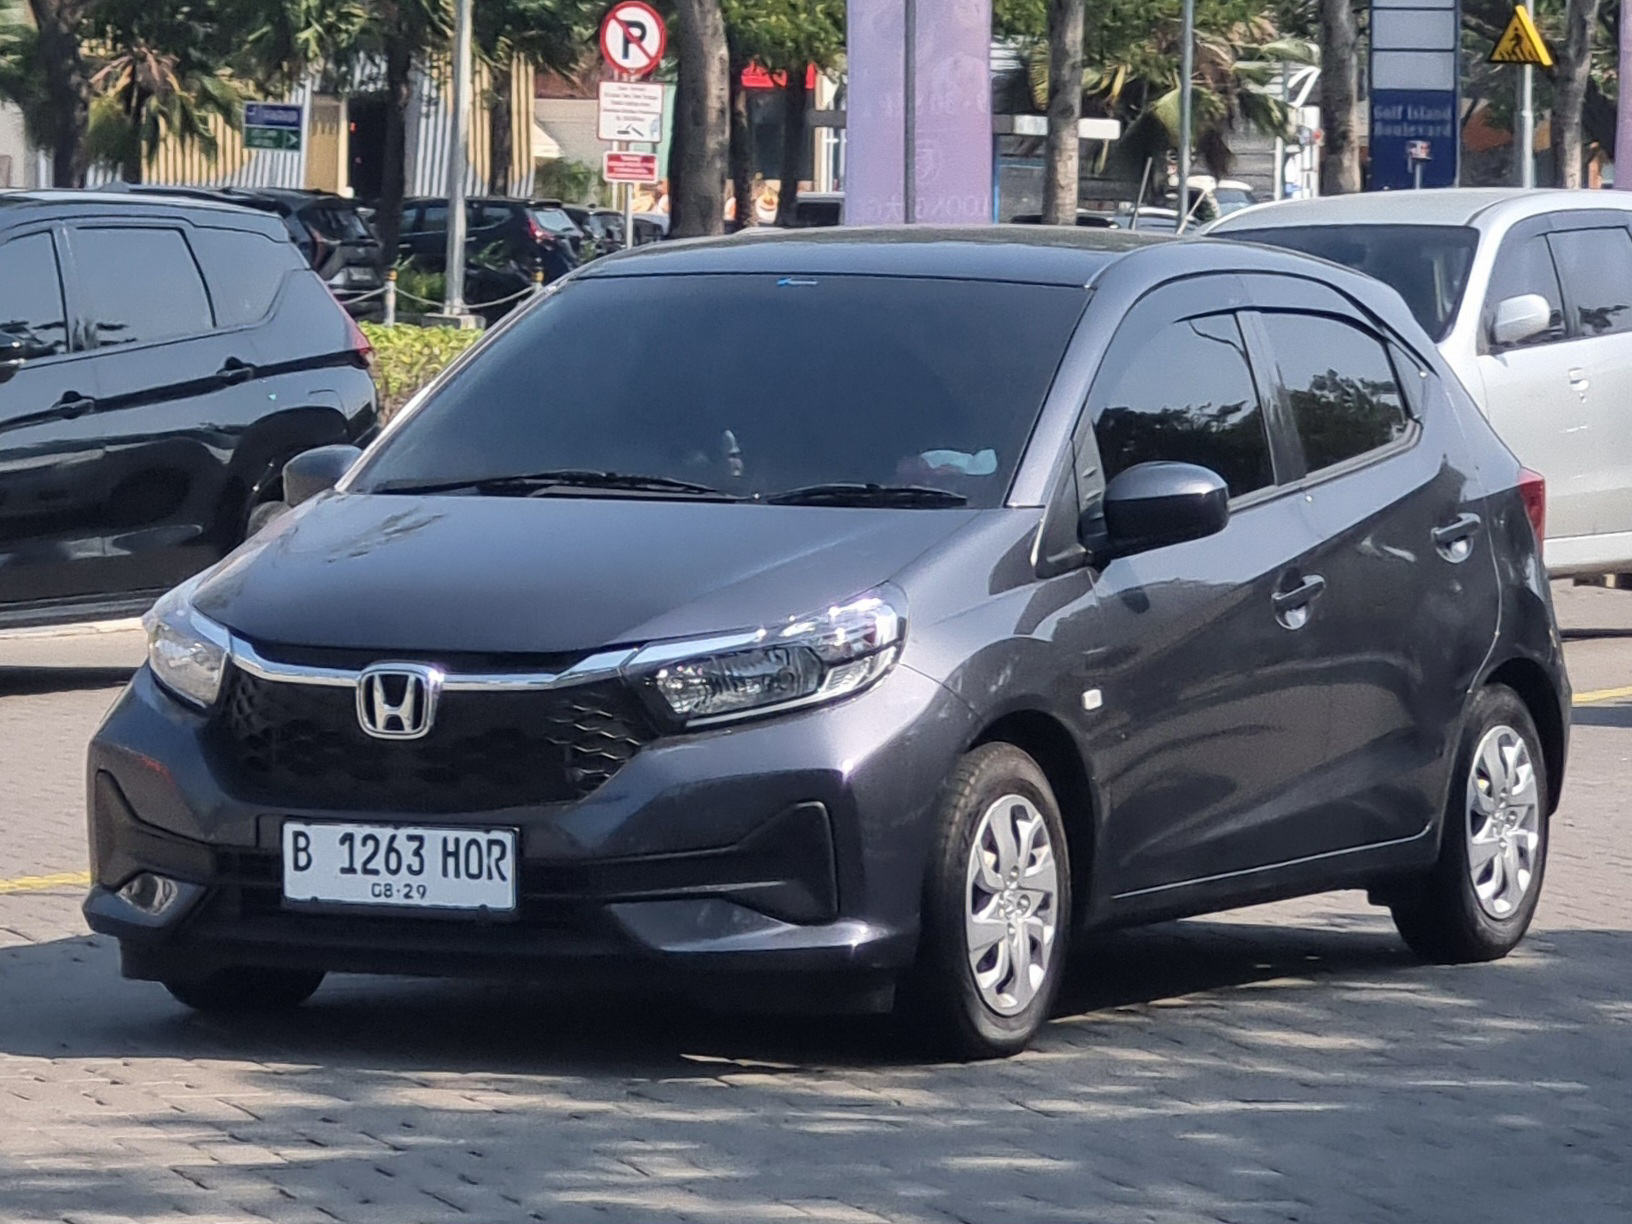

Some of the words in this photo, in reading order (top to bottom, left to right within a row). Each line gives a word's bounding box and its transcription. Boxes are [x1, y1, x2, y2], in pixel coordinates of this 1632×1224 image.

[292, 830, 312, 872] B
[338, 832, 425, 876] 1263
[442, 836, 508, 882] HOR
